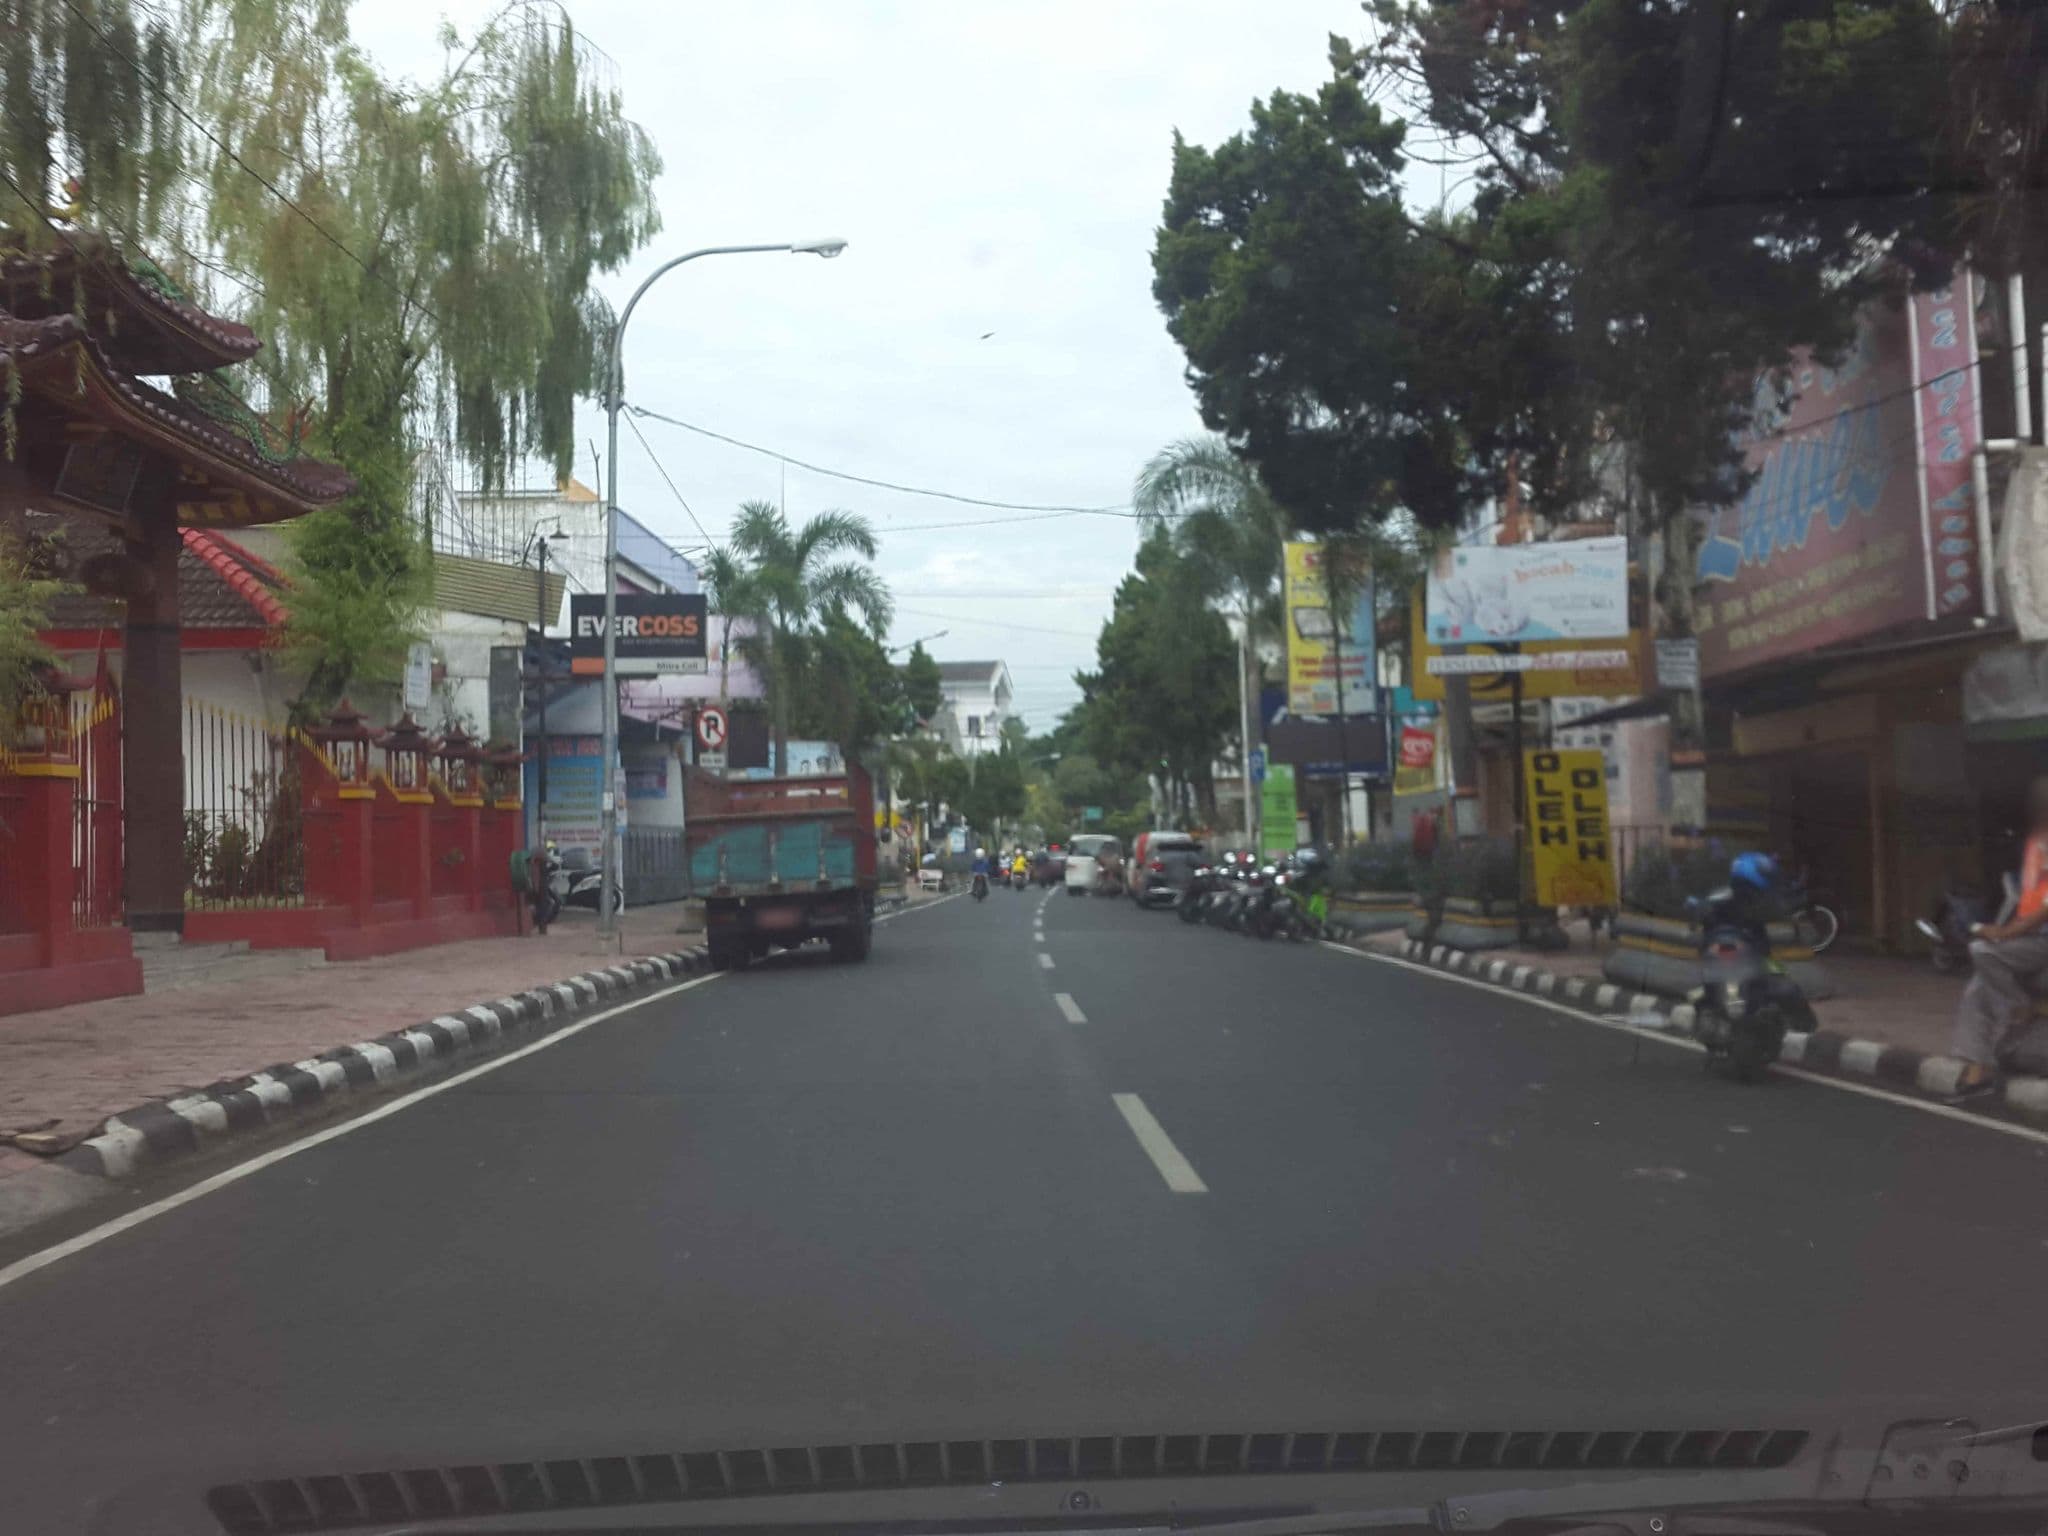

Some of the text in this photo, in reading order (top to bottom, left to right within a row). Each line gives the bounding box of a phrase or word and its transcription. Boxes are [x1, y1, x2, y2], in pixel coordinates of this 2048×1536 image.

[578, 615, 698, 637] EVERCOSS
[1533, 753, 1568, 845] OLEH
[1571, 768, 1606, 860] OLEH
